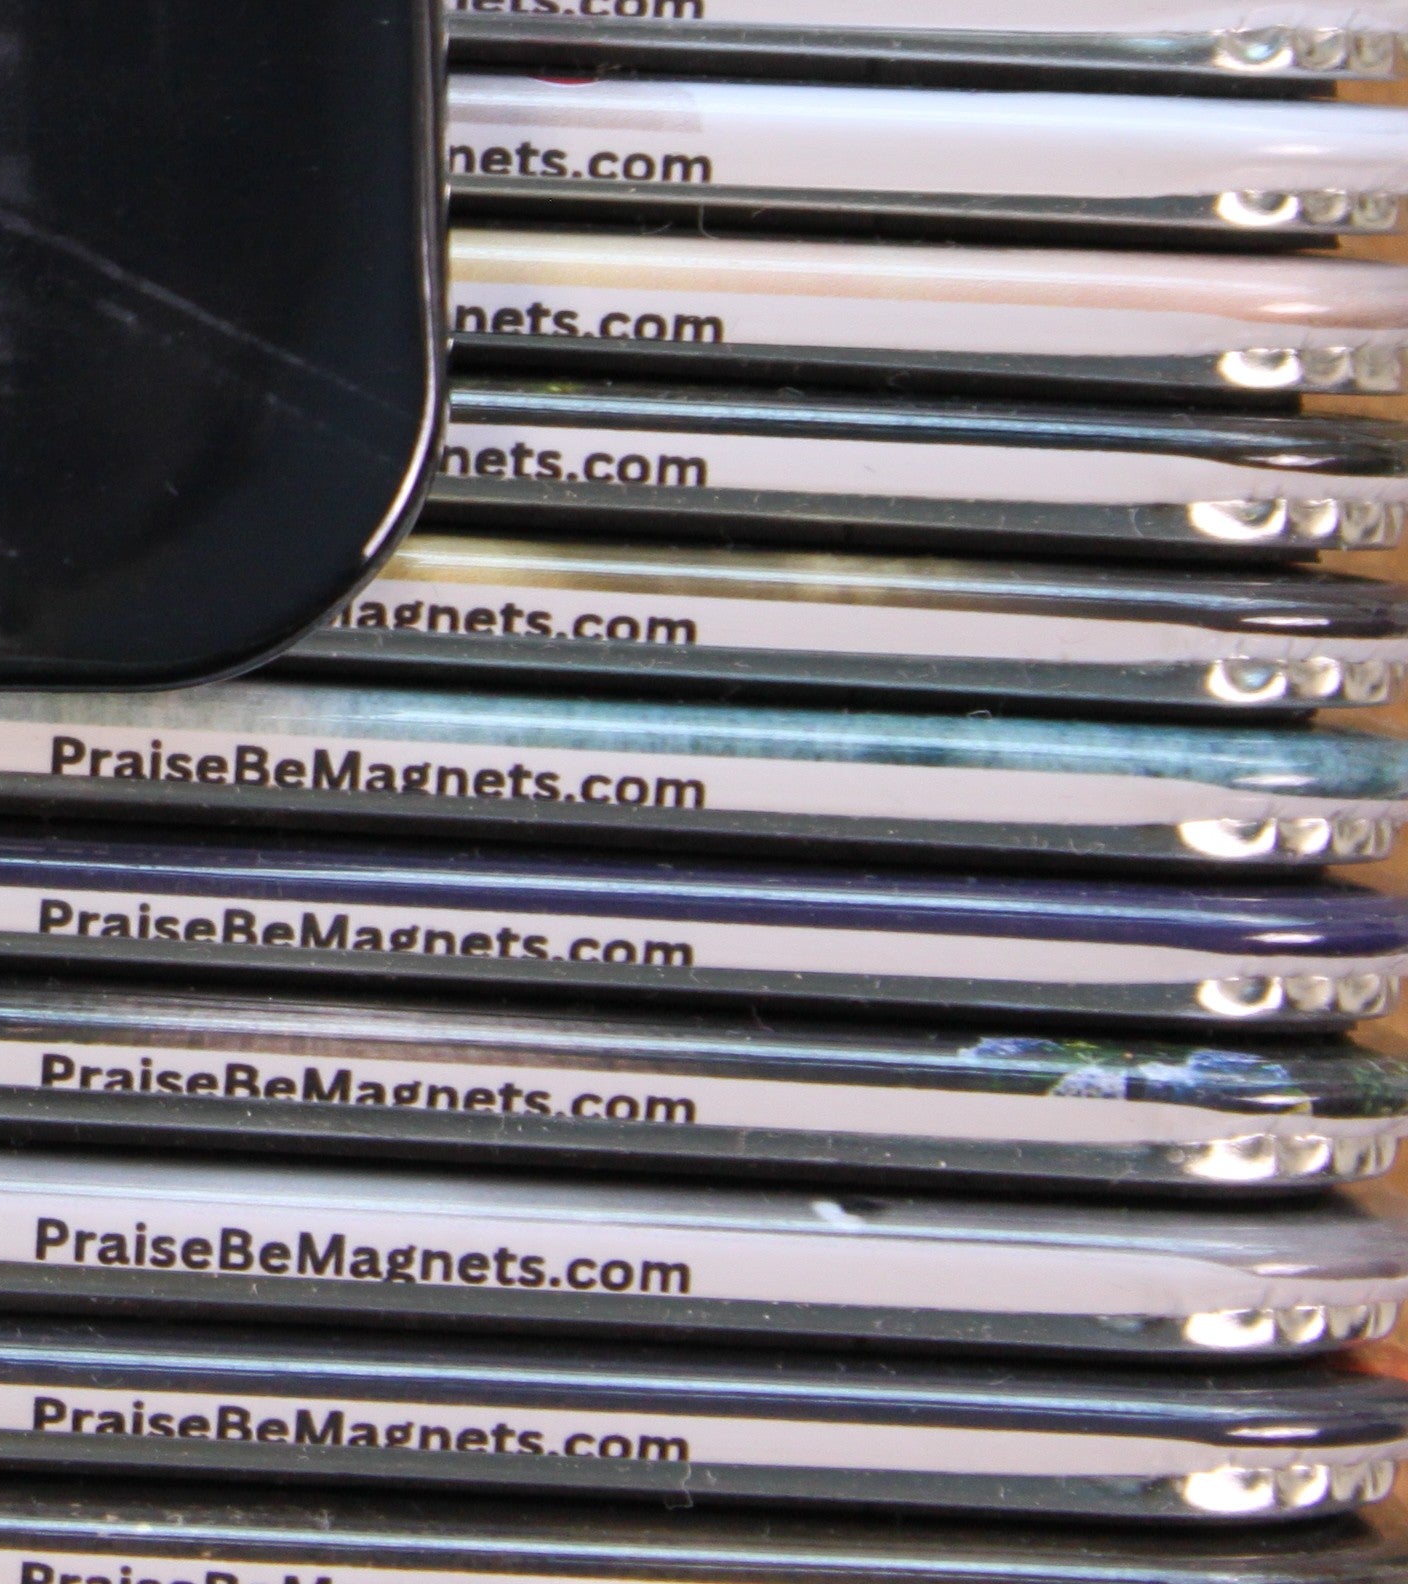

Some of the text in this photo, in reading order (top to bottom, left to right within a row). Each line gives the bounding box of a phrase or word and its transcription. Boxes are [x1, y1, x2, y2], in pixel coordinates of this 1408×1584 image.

[51, 734, 706, 809] PraiseBeMagnets.com
[39, 898, 695, 967] PraiseBeMagnets.com
[40, 1052, 696, 1124] PraiseBeMagnets.com
[34, 1216, 691, 1293] PraiseBeMagnets.com
[32, 1395, 689, 1462] PraiseBeMagnets.com
